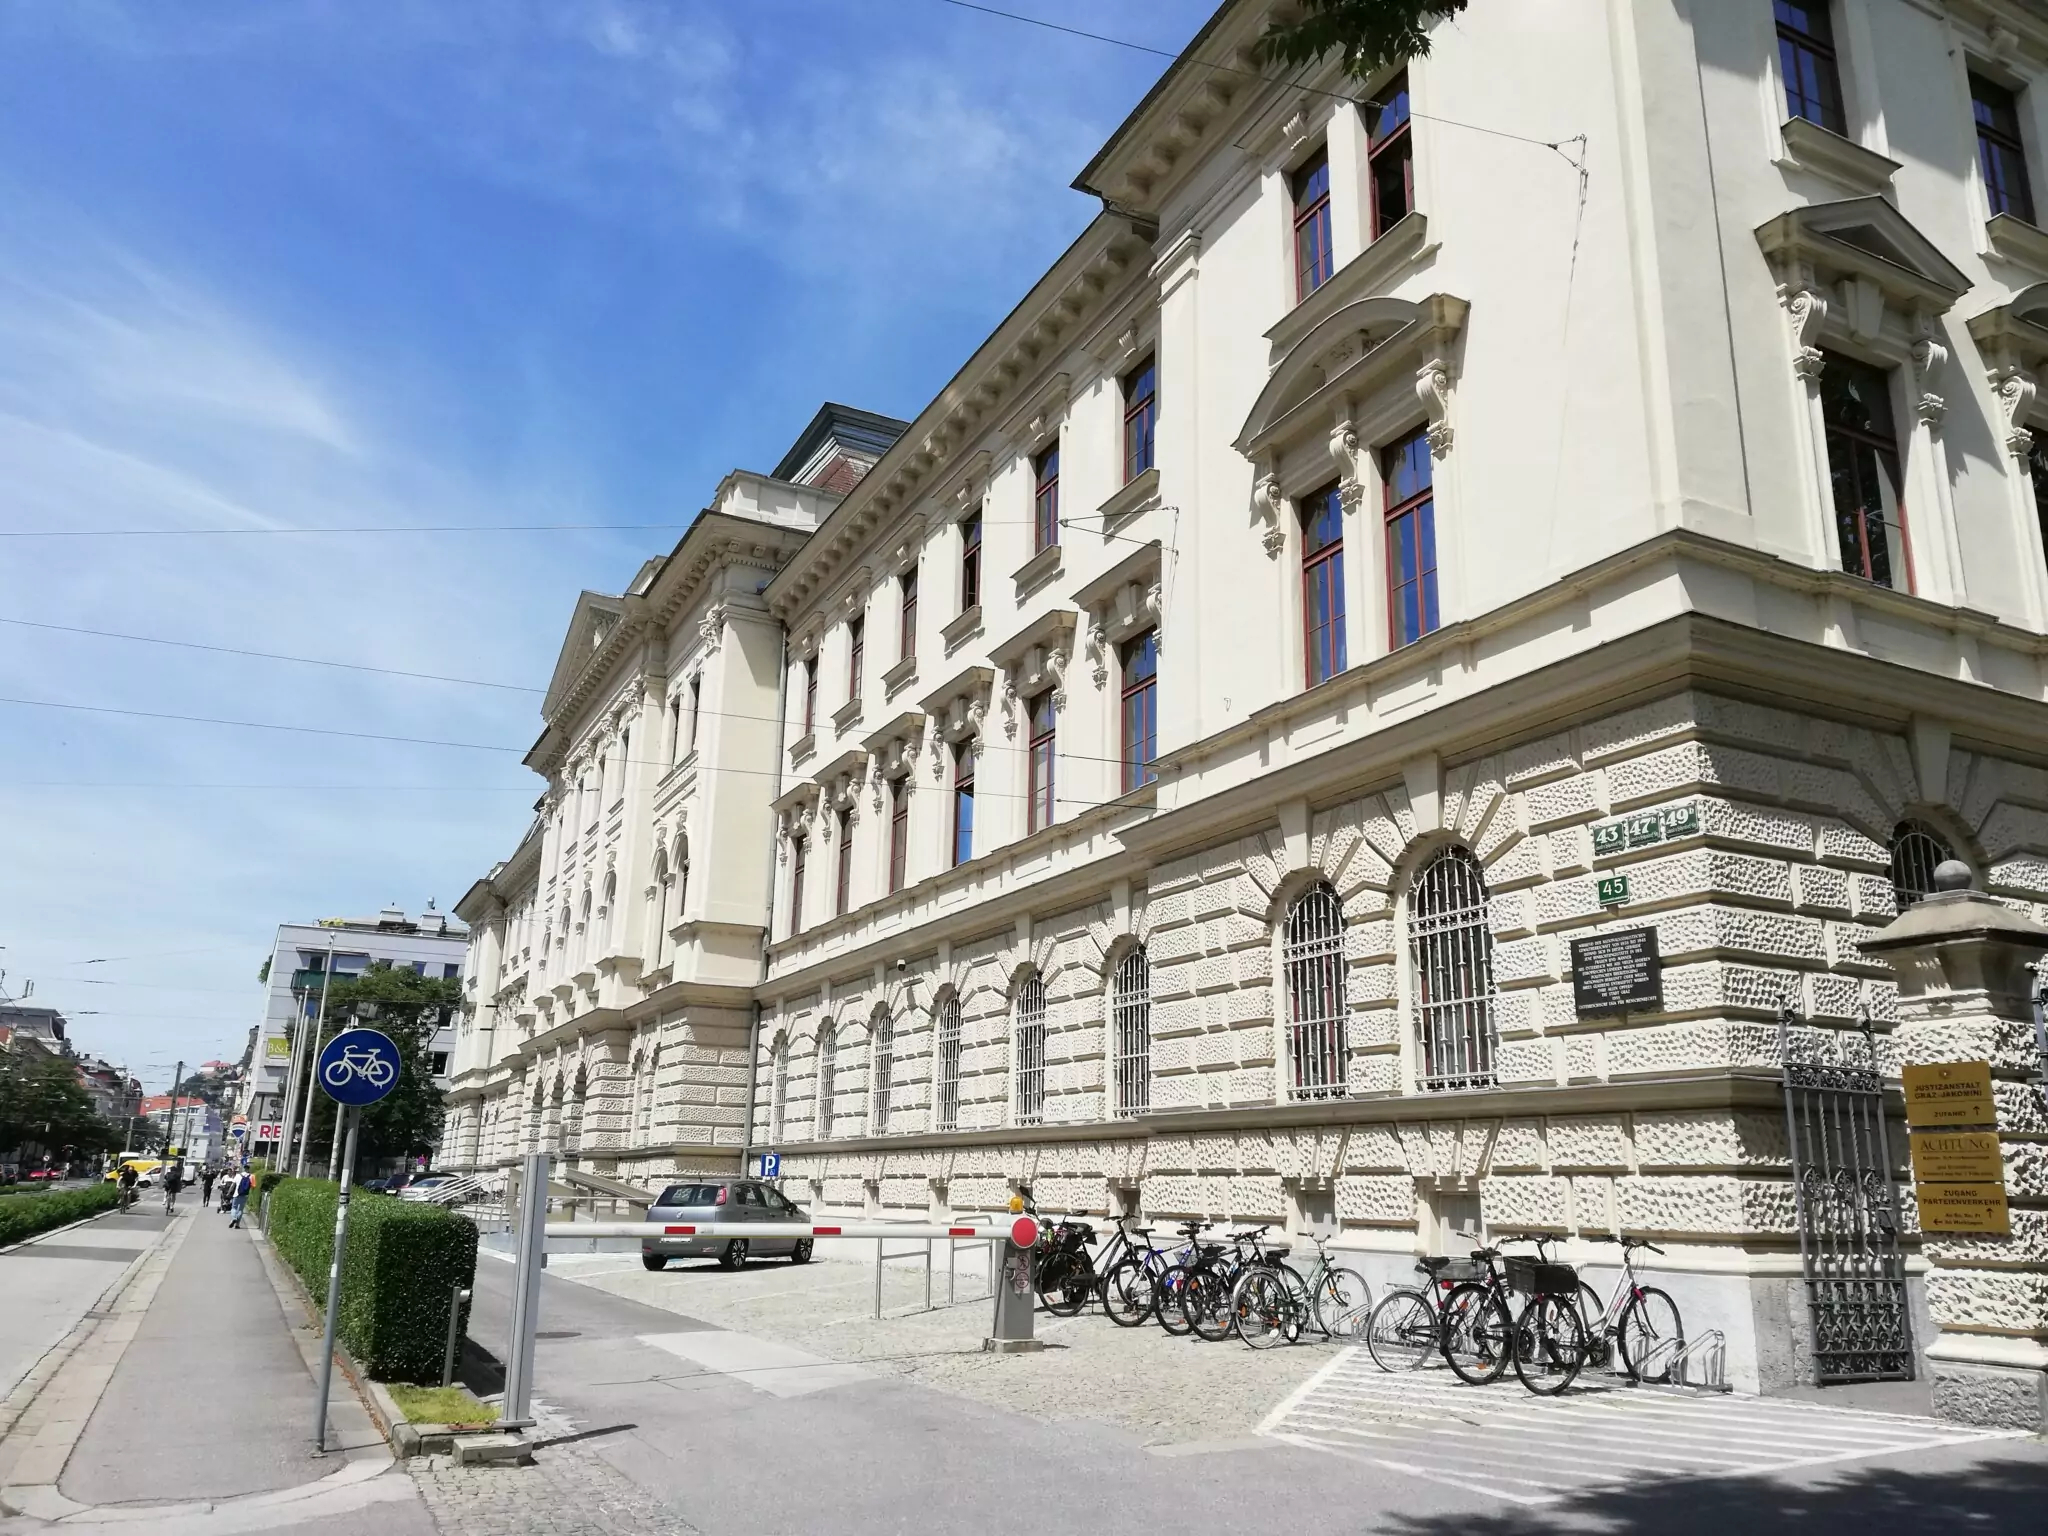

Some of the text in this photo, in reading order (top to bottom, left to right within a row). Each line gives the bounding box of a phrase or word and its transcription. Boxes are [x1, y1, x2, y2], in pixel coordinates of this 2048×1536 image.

[1596, 826, 1619, 843] 43
[1602, 878, 1623, 896] 45
[1914, 1081, 1981, 1092] JUSTIZANSTALT
[1920, 1138, 1990, 1150] ACHTUNG
[765, 1155, 776, 1175] P
[1943, 1189, 1978, 1197] ZUGANG
[1923, 1198, 2001, 1206] PARTEIENVERKEHR
